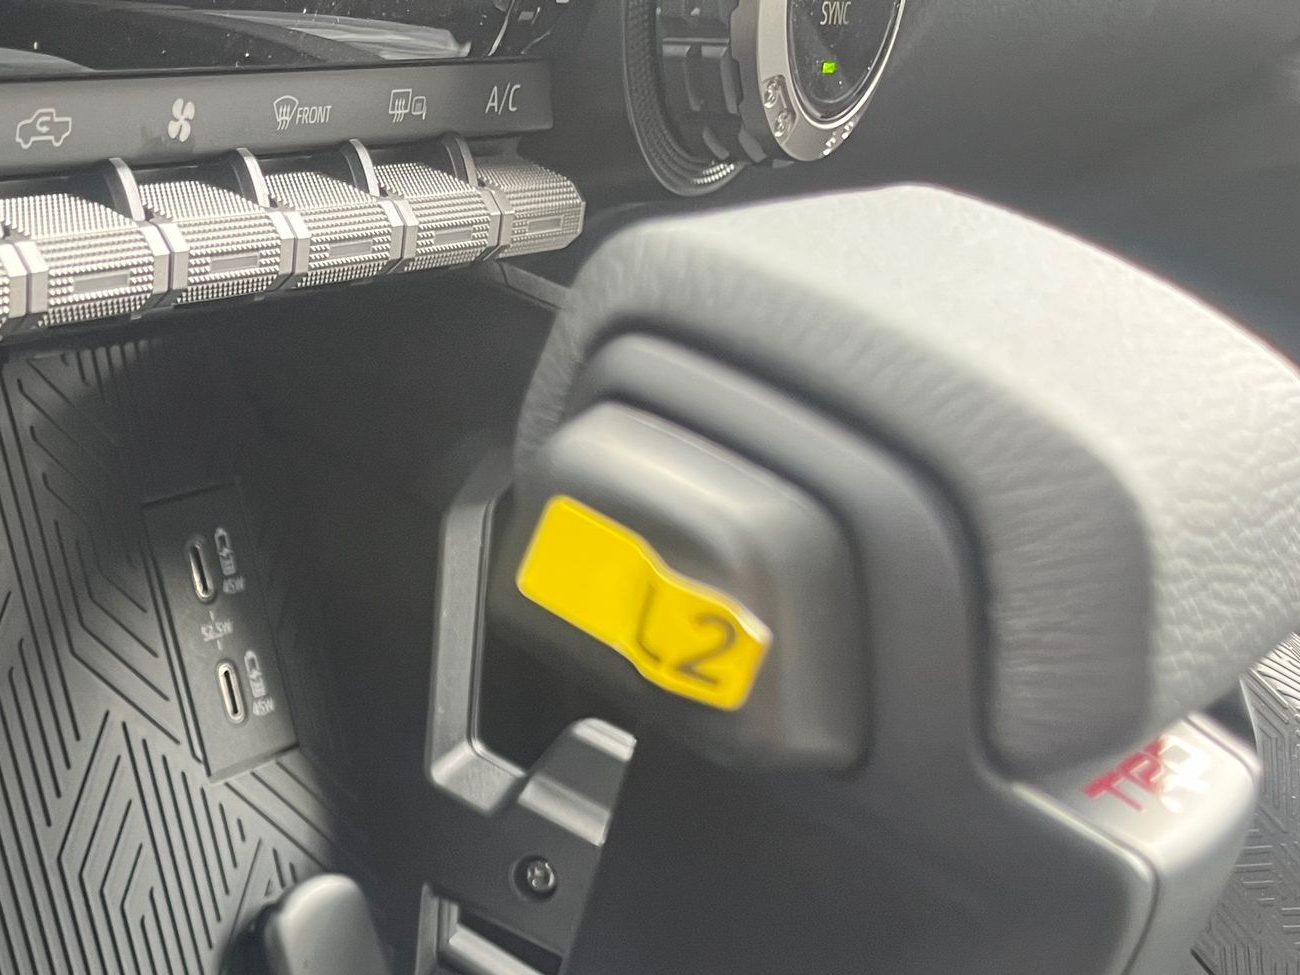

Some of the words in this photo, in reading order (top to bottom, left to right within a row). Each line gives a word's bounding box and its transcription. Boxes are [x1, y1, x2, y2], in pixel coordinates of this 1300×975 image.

[820, 1, 851, 25] SYNC
[485, 83, 520, 114] A/C
[296, 105, 332, 124] FRONT
[635, 582, 736, 687] L2
